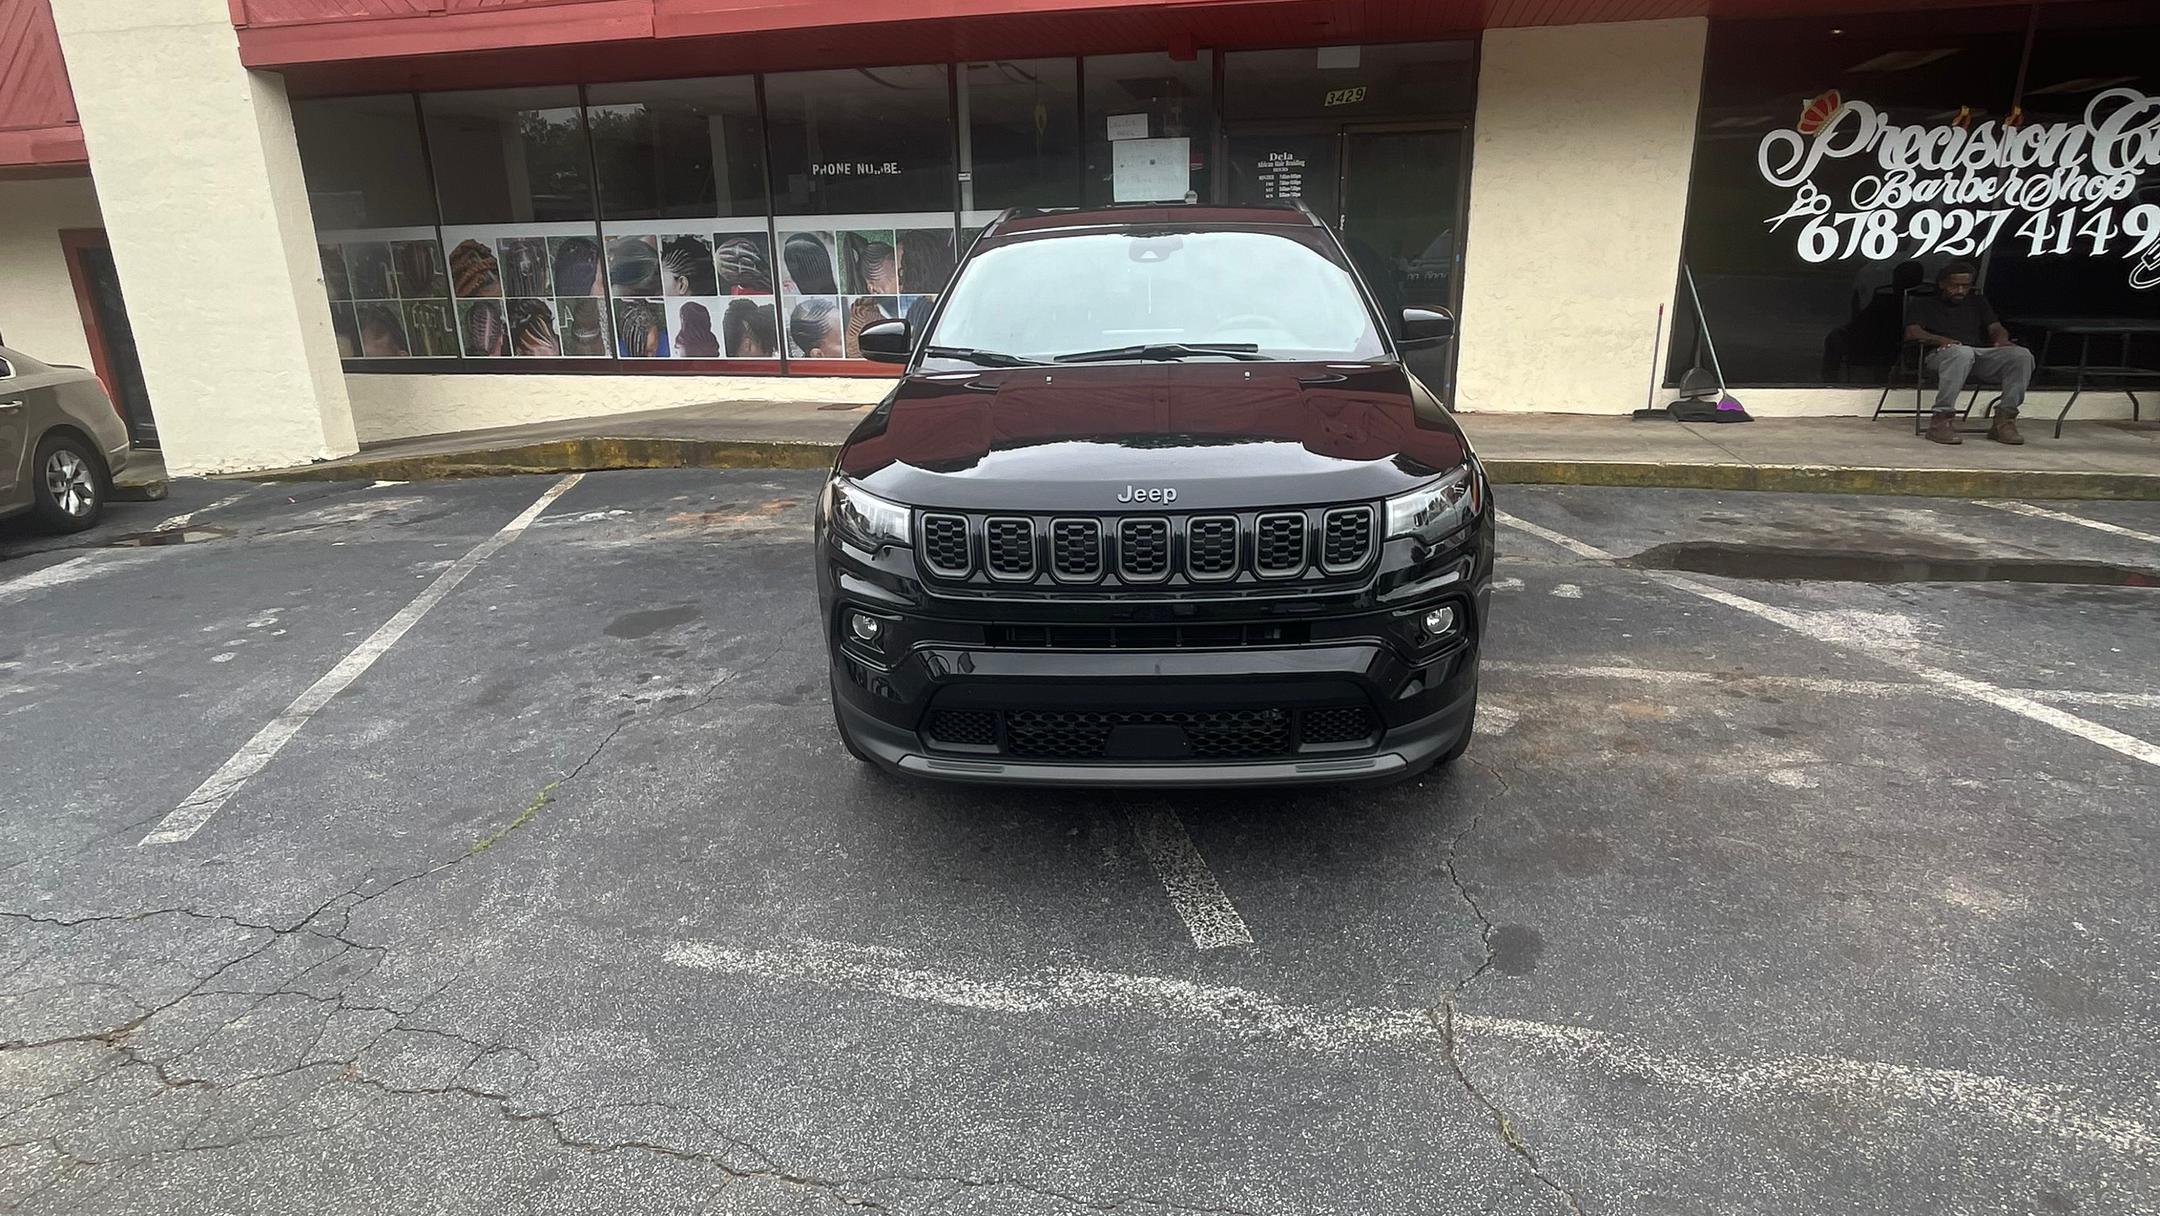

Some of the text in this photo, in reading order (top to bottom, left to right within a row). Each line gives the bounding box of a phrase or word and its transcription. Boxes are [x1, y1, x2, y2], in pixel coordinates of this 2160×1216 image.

[1327, 88, 1364, 105] 3429
[1758, 99, 2087, 188] Precision
[857, 162, 901, 175] NUBE
[2014, 204, 2160, 259] 4149
[1117, 485, 1178, 505] Jeep
